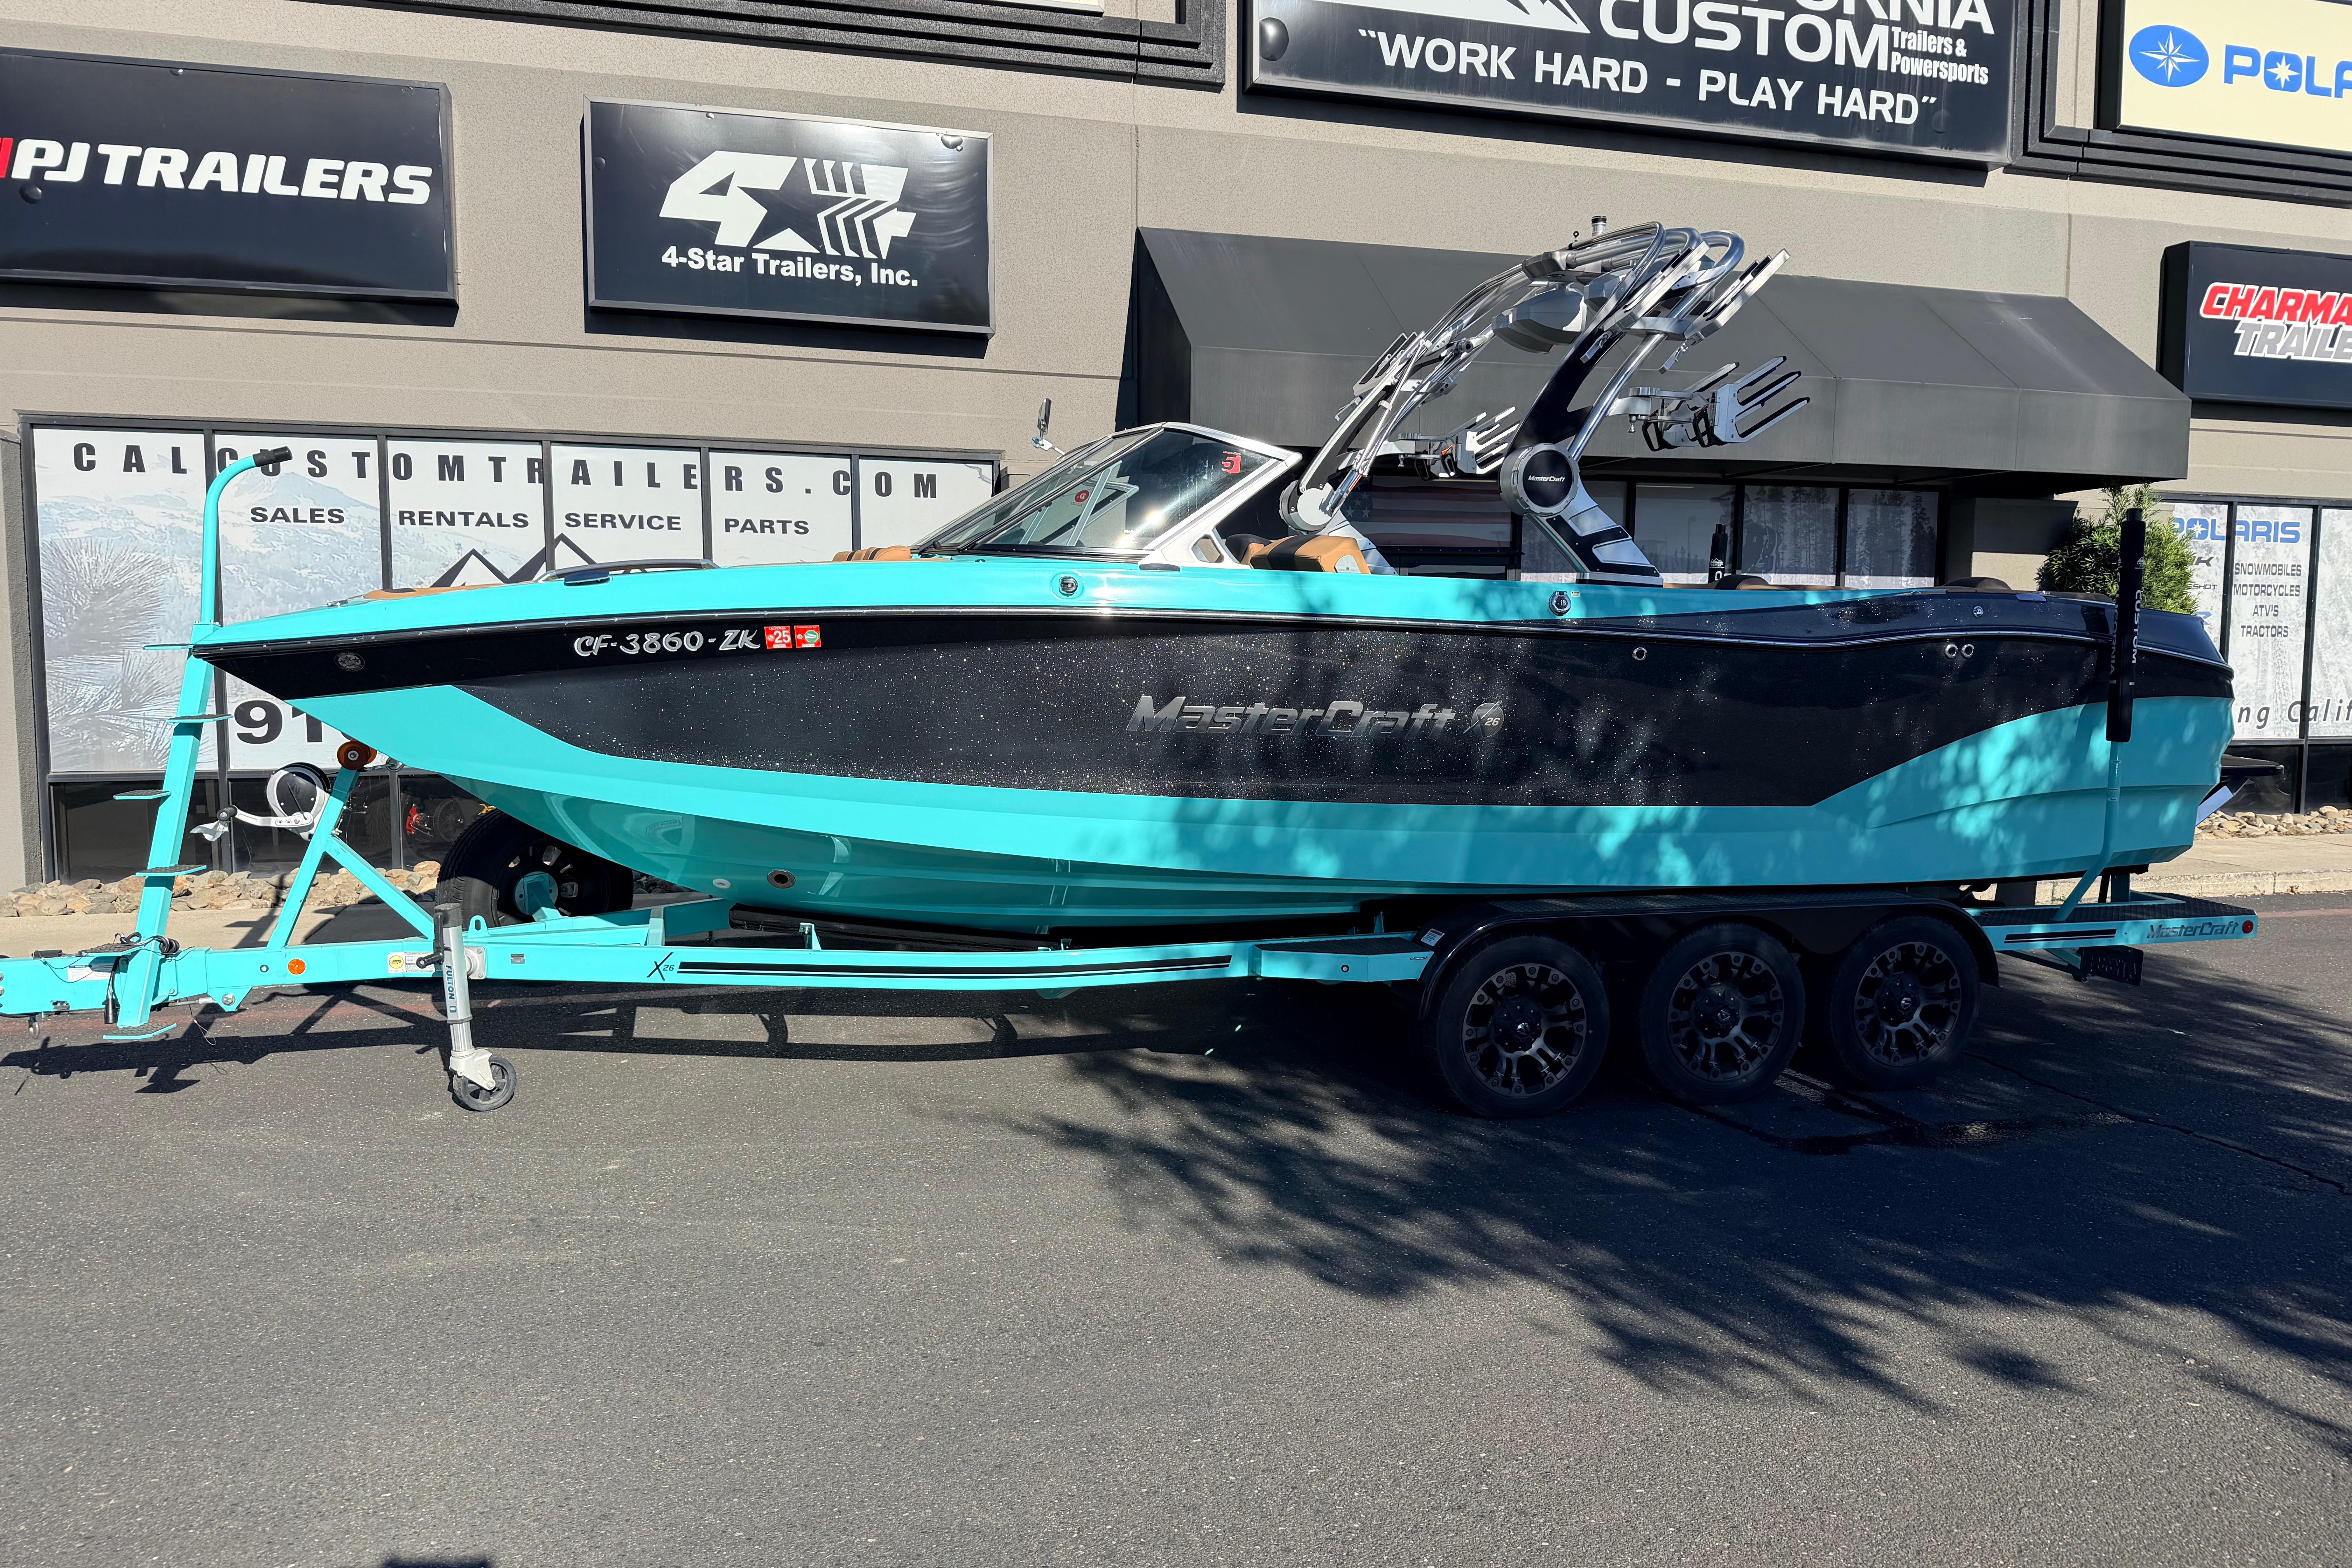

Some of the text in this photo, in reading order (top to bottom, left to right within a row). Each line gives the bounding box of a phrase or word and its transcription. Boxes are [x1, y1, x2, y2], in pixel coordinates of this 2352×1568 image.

[1600, 0, 1889, 71] CUSTOM
[1891, 26, 1967, 57] Trailers &
[1535, 50, 1648, 93] HARD
[1666, 78, 1681, 86] -
[1699, 69, 1804, 111] PLAY
[1891, 51, 1988, 85] Powersports
[12, 139, 432, 205] PJ TRAILERS
[662, 246, 918, 287] 4-Star Trailers, Inc.
[251, 507, 809, 535] SALES RENTALS SERVICE PARTS
[2173, 517, 2301, 544] POLARIS
[2235, 562, 2302, 577] SNOWMOBILES
[2233, 583, 2301, 597] MOTORCYCLES
[2132, 589, 2142, 663] CUSTOM
[2252, 604, 2279, 617] ATV'S
[774, 630, 791, 643] 25
[2240, 625, 2289, 638] TRACTORS
[234, 700, 352, 744] 91
[1127, 695, 1455, 740] MasterCraft
[2147, 921, 2239, 939] MasterCraft
[446, 965, 455, 1000] FULTON
